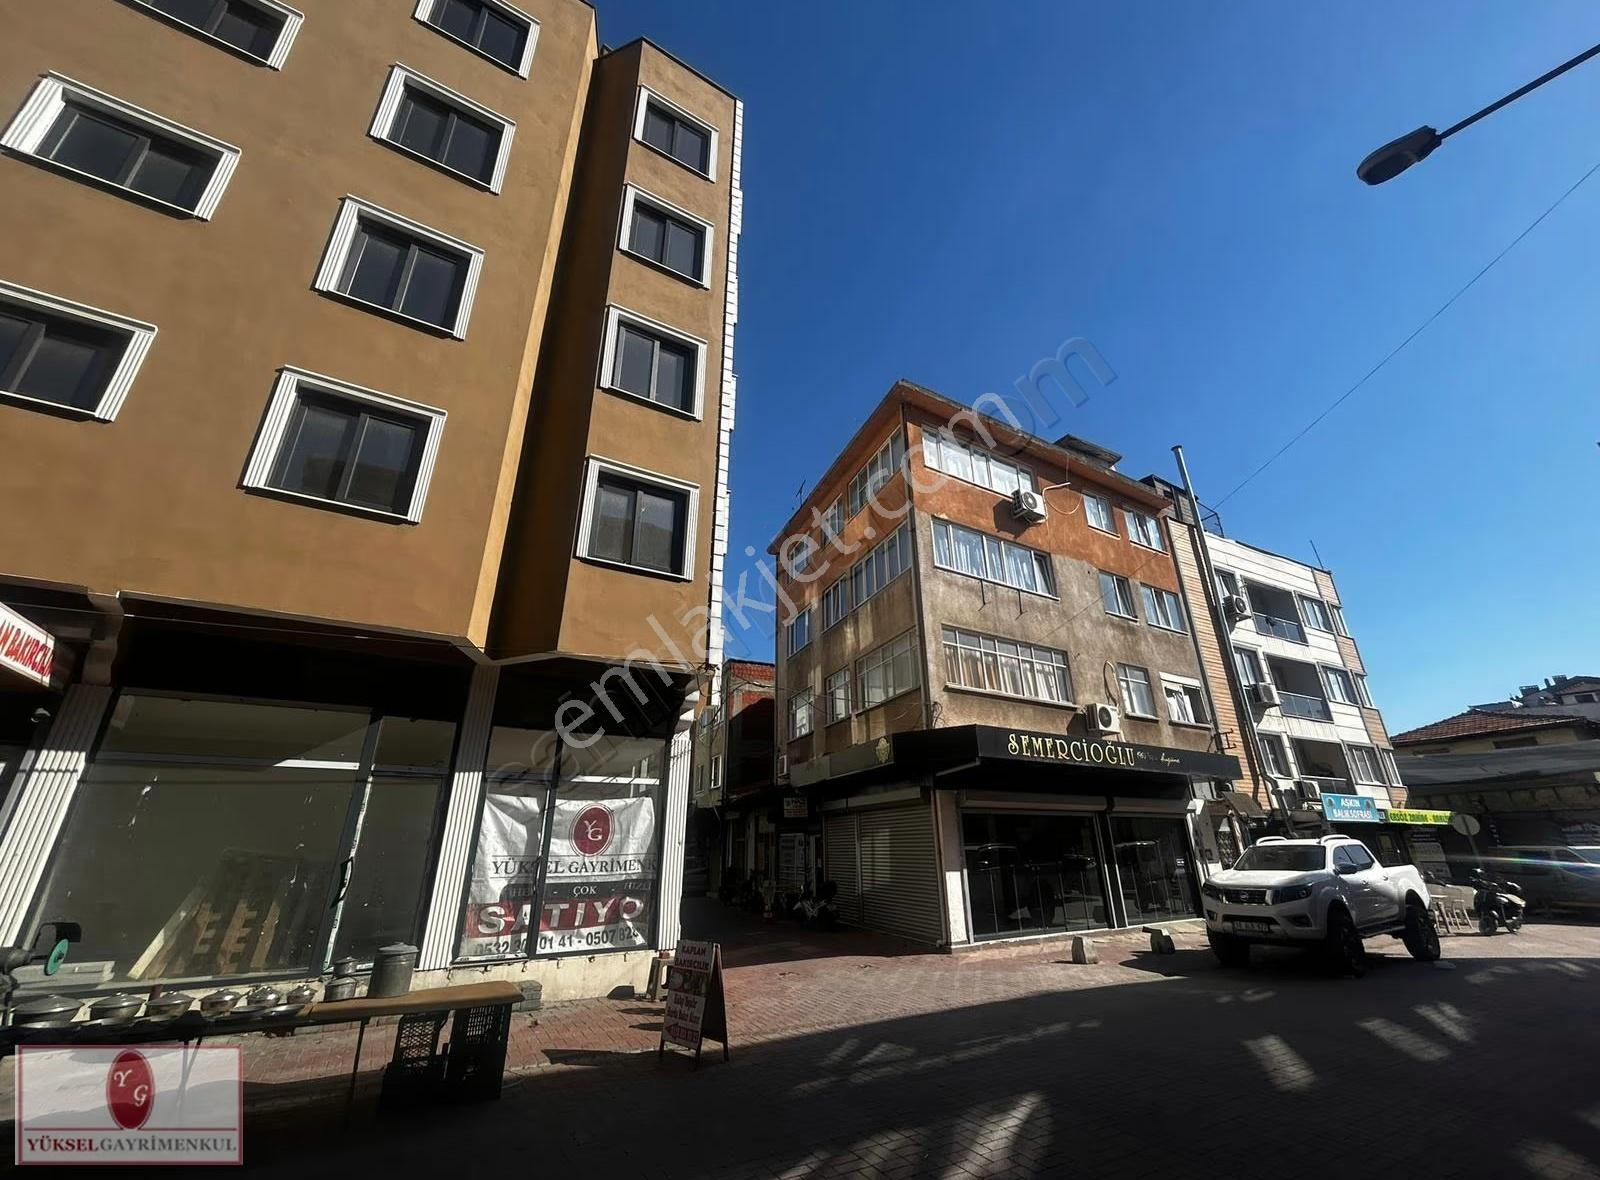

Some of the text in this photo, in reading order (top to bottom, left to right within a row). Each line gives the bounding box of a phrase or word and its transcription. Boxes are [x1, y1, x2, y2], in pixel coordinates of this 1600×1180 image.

[1007, 733, 1135, 766] SEMERCİOĞLU
[573, 885, 598, 898] ÇOK
[558, 934, 574, 948] 41
[586, 930, 617, 946] 0507
